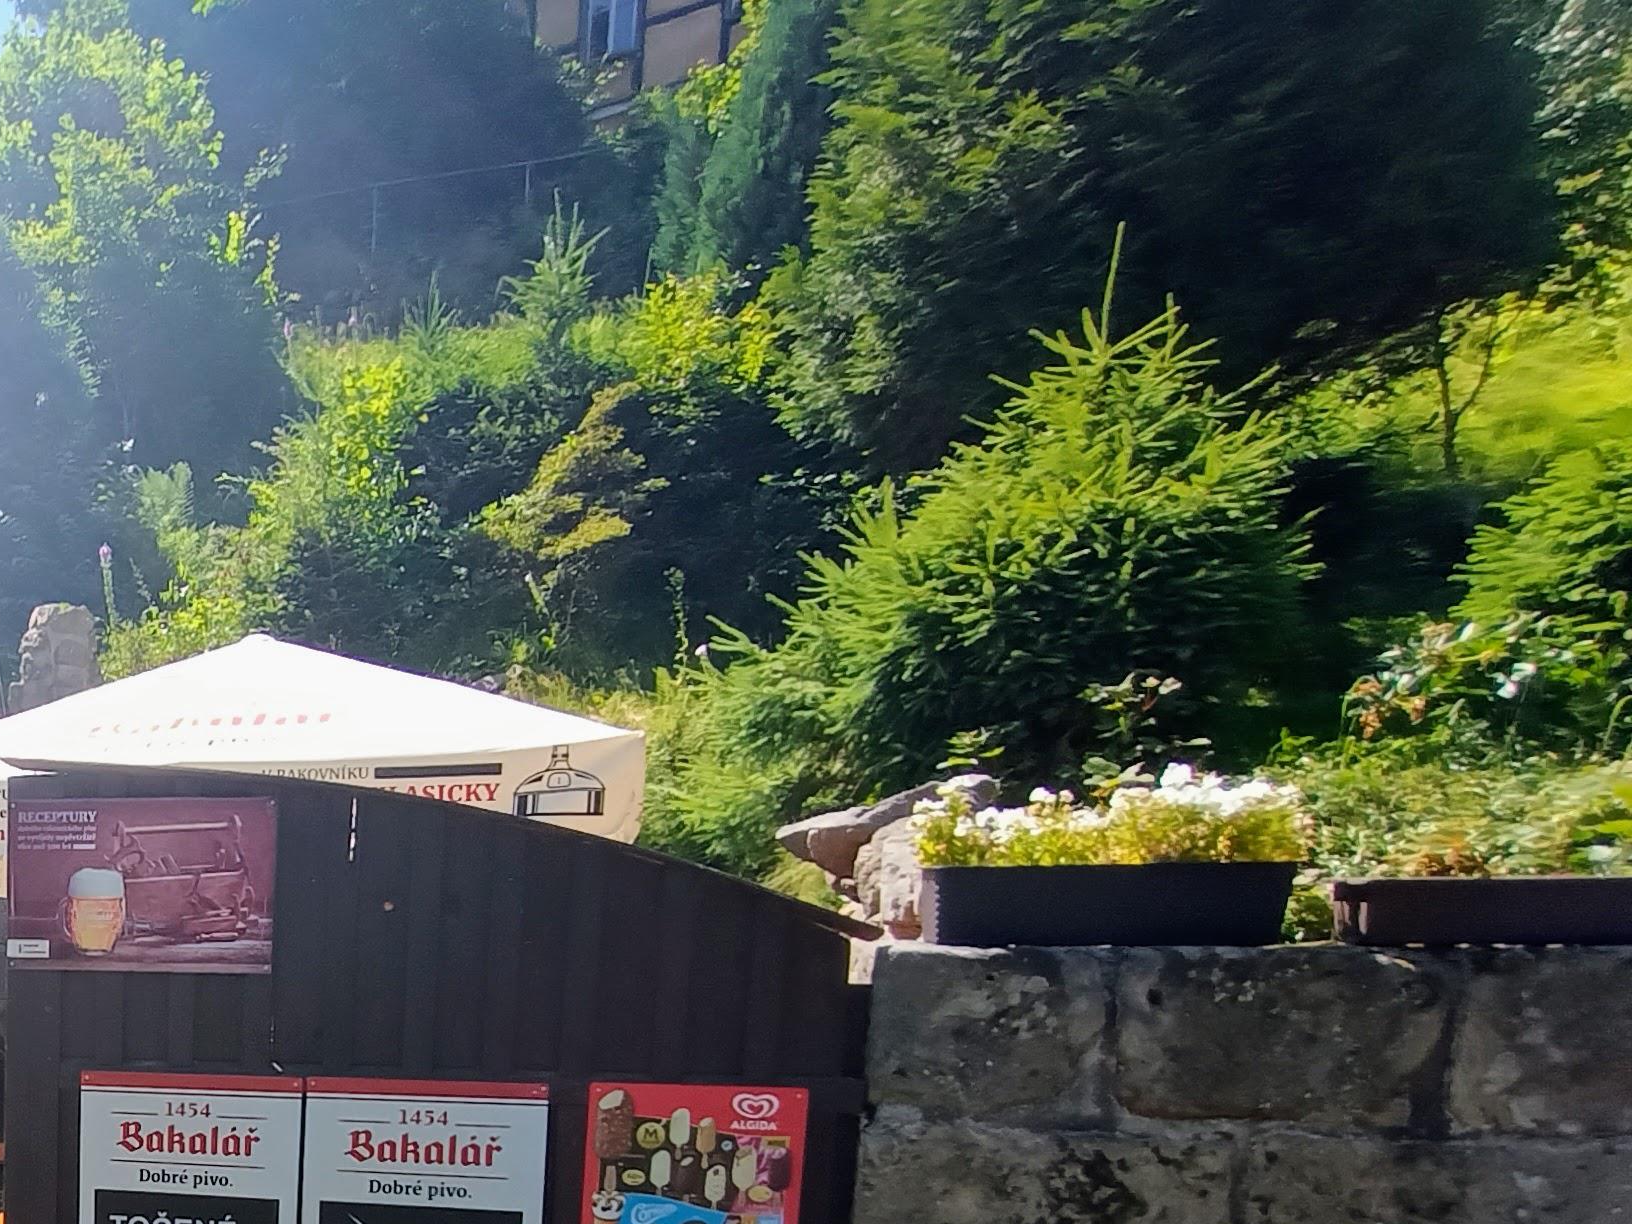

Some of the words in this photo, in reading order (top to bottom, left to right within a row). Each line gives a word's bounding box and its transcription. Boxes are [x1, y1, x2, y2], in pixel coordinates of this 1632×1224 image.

[378, 783, 500, 802] ASICKY
[17, 810, 97, 823] RECEPTURY
[164, 1101, 212, 1118] 1454
[398, 1109, 449, 1126] 1454
[730, 1120, 778, 1131] ALGIDA
[116, 1120, 261, 1157] Bakalář
[344, 1129, 503, 1167] Bakalář
[139, 1168, 188, 1184] Dobré
[193, 1171, 234, 1189] pivo.
[368, 1179, 423, 1196] Dobré
[428, 1182, 472, 1200] pivo.
